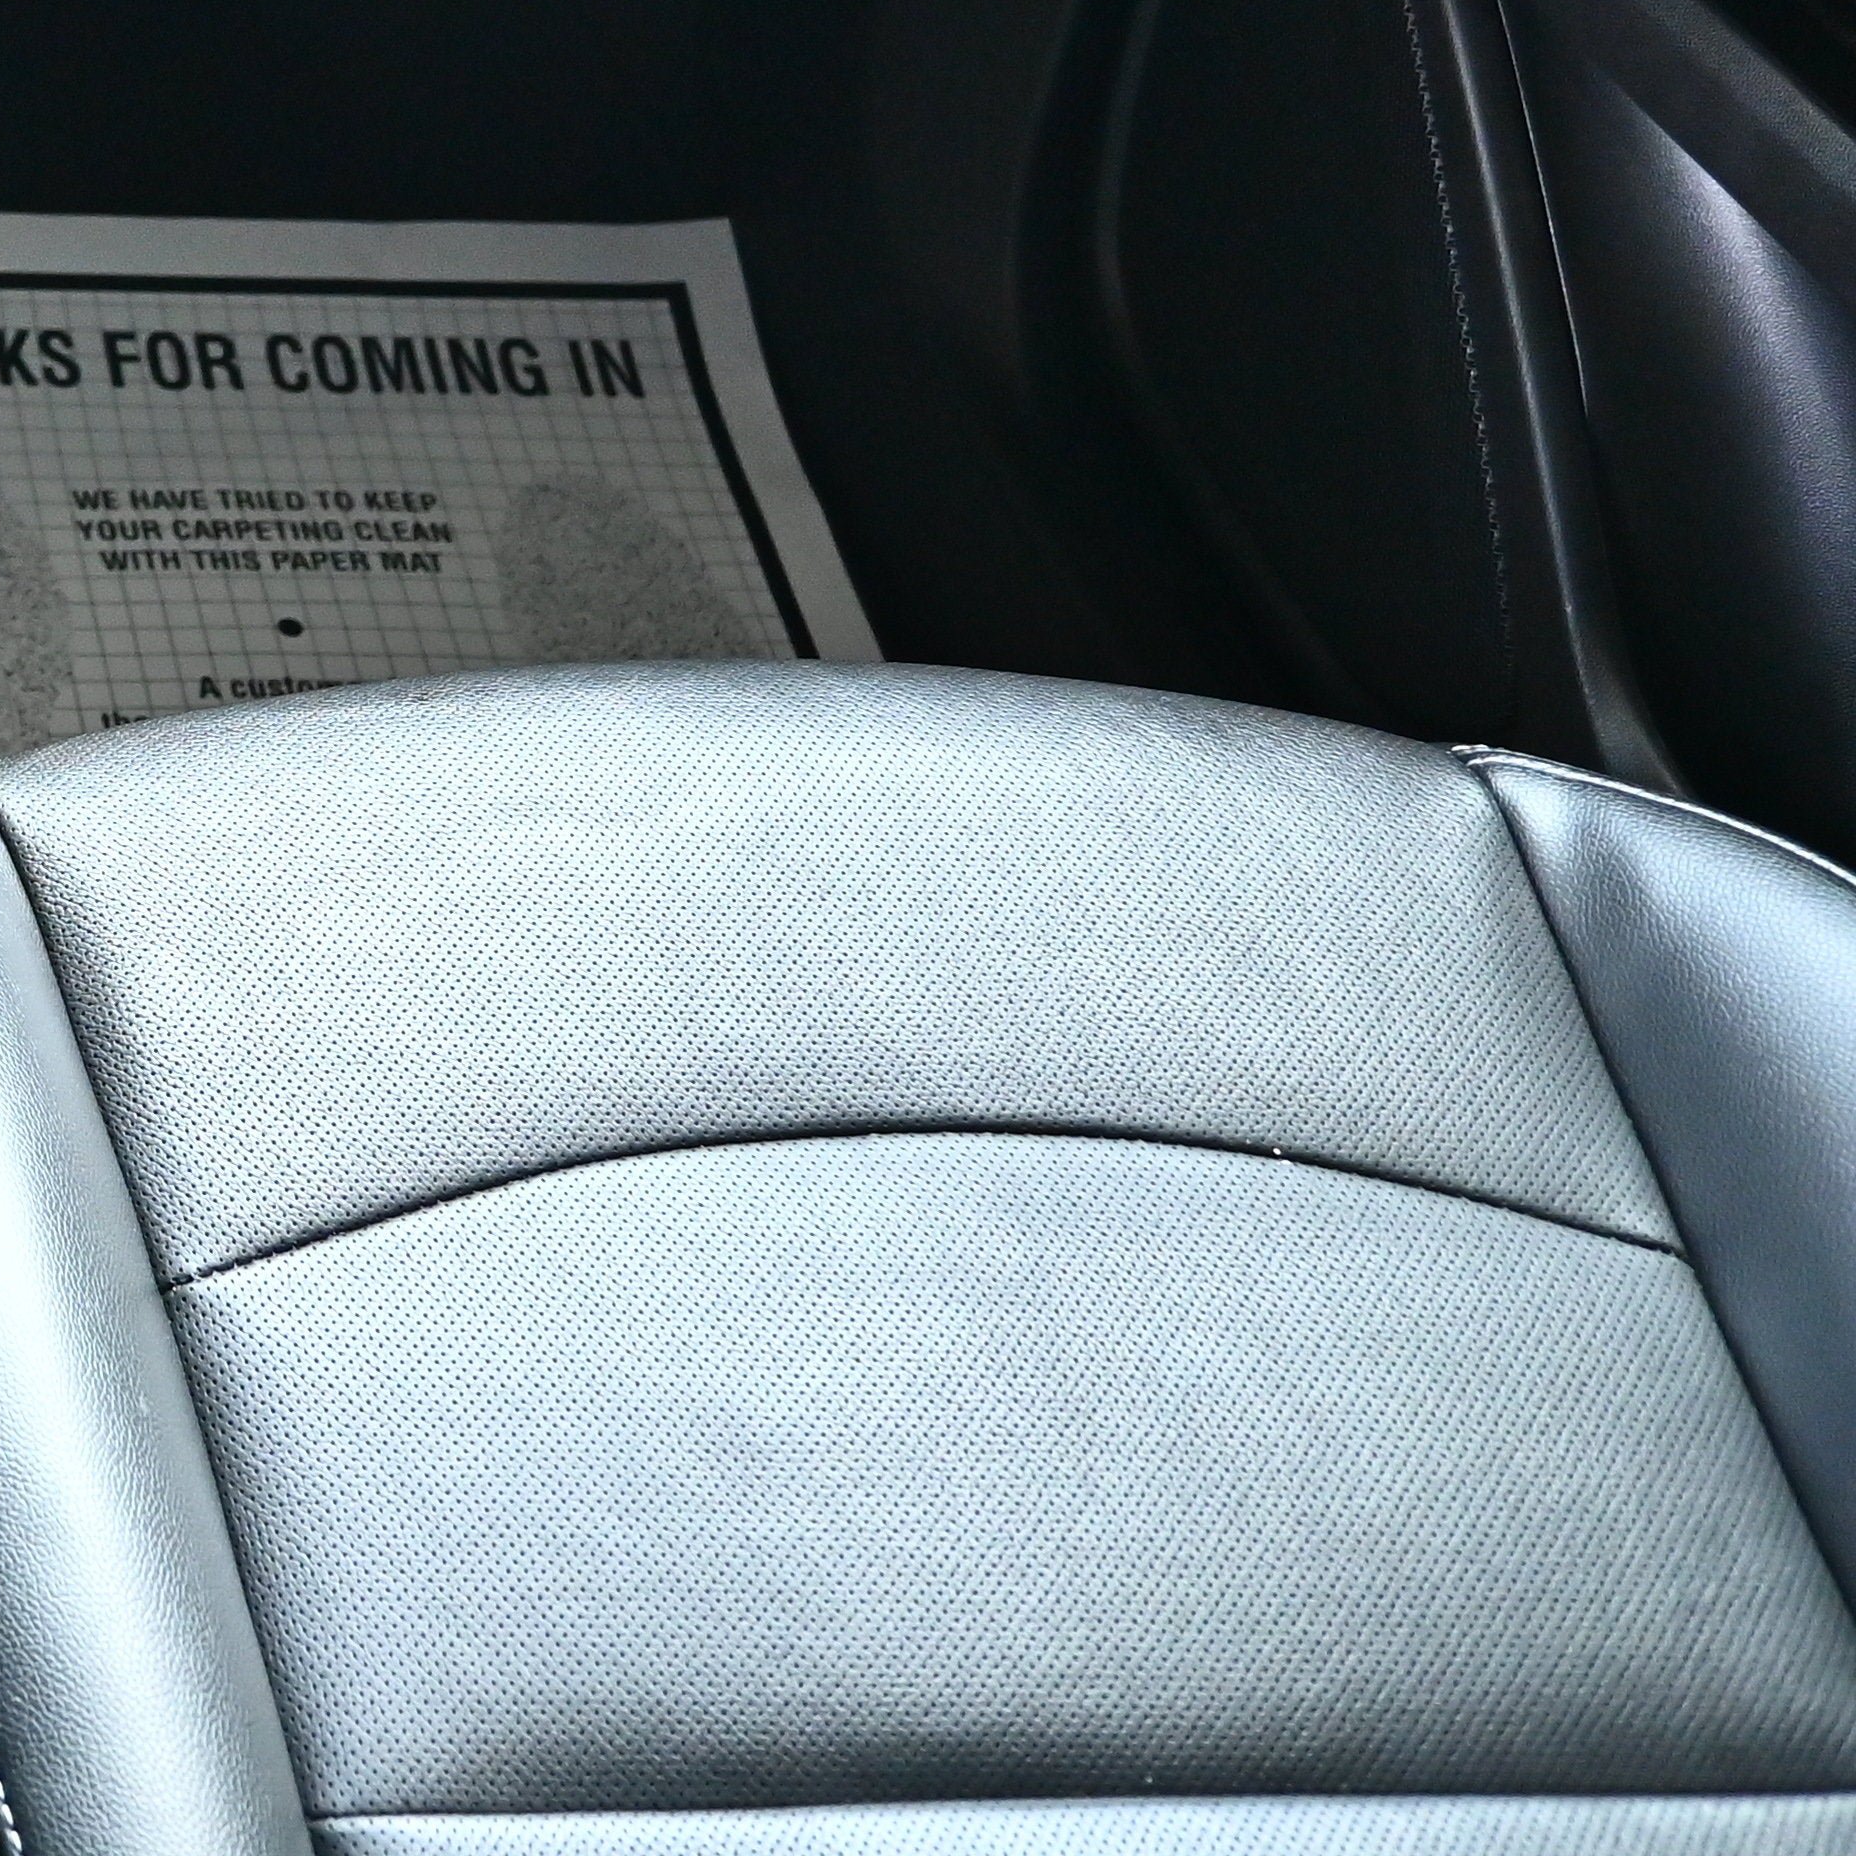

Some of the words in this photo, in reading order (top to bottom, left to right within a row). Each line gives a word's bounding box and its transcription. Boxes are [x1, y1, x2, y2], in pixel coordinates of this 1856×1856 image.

[105, 333, 245, 392] FOR
[267, 335, 549, 397] COMING
[572, 341, 647, 399] IN
[72, 489, 118, 511] WE
[131, 489, 207, 511] HAVE
[219, 490, 304, 511] TRIED
[319, 491, 353, 511] TO
[366, 492, 437, 512] KEEP
[76, 519, 161, 541] YOUR
[173, 520, 343, 542] CARPETING
[354, 521, 452, 542] CLEAN
[99, 550, 181, 572] WITH
[194, 550, 260, 571] THIS
[273, 551, 370, 572] PAPER
[382, 552, 443, 573] MAT
[199, 677, 223, 699] A
